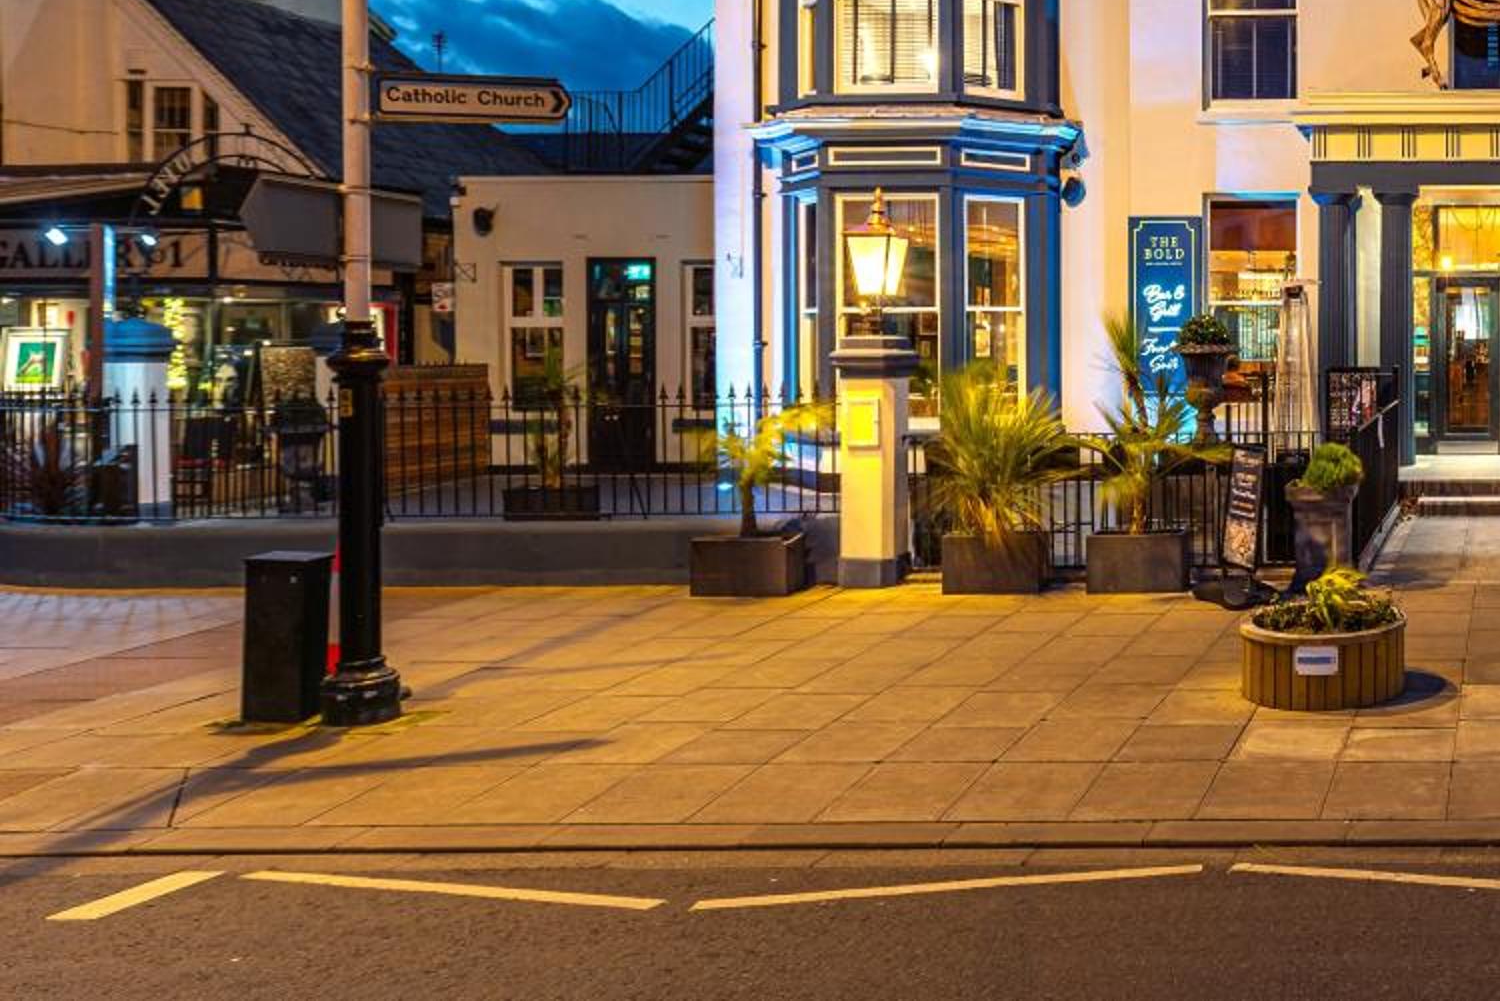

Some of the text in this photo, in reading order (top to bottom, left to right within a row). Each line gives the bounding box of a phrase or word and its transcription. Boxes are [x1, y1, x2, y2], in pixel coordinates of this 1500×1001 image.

[386, 86, 546, 108] Catholic Church
[1150, 236, 1179, 248] THE
[1143, 248, 1186, 261] BOLD
